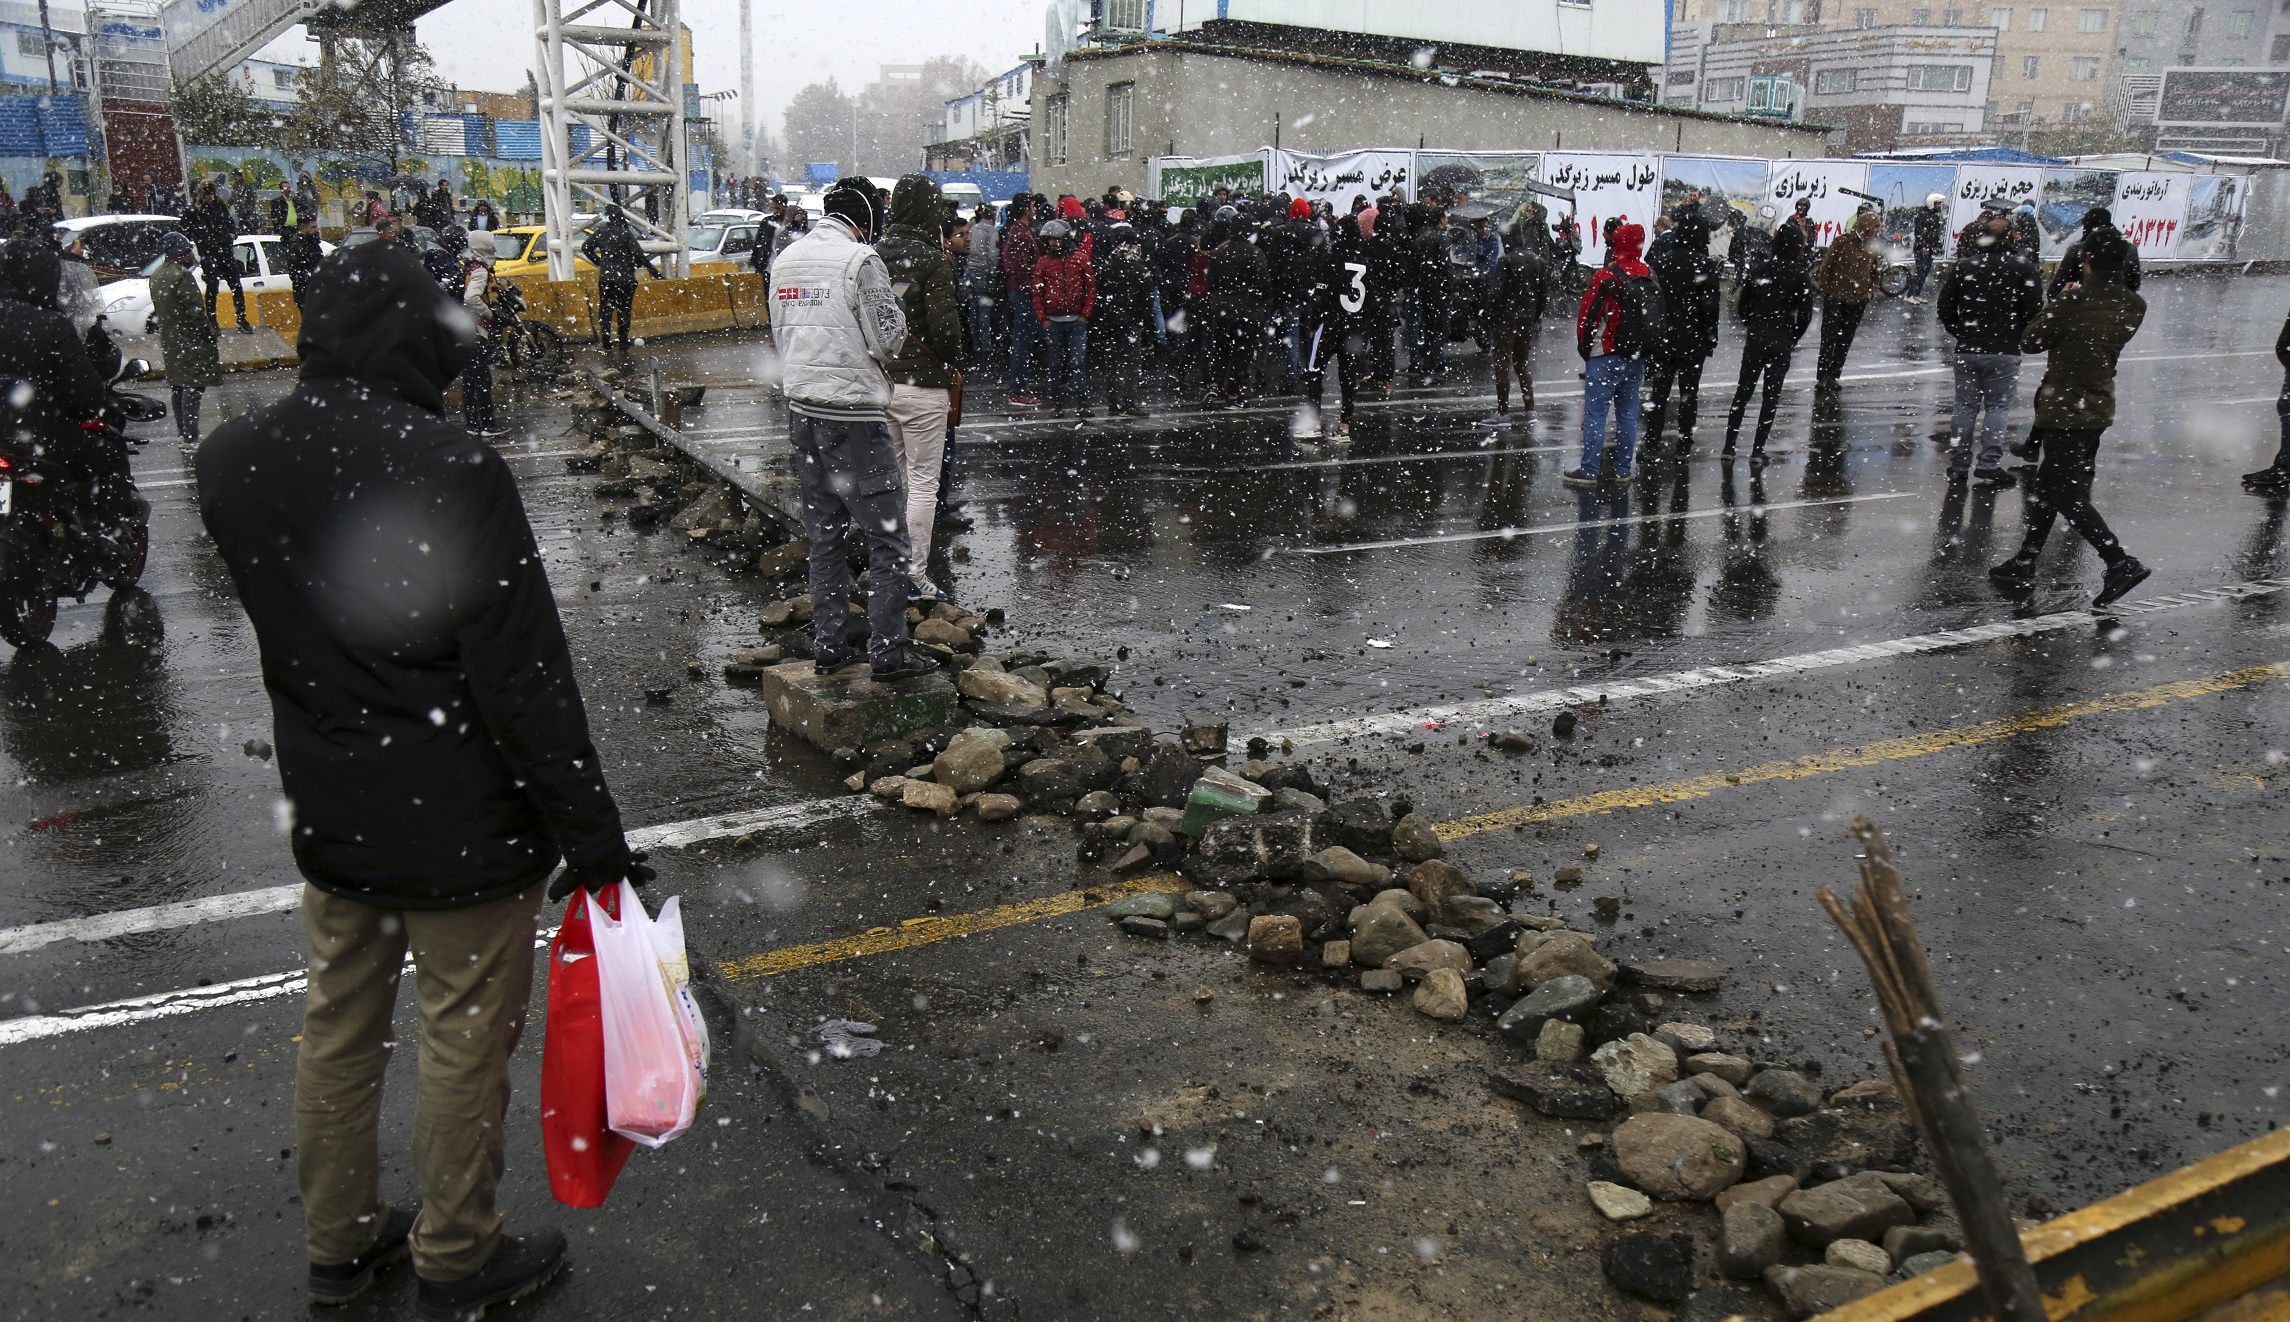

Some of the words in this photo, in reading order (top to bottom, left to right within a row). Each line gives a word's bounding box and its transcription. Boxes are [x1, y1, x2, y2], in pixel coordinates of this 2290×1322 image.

[1279, 160, 1328, 192] زیرگذر
[1329, 170, 1364, 192] مسیر
[1370, 162, 1407, 192] عرض
[1549, 162, 1589, 192] زیرگذر
[1591, 172, 1621, 192] مسیر
[1626, 164, 1655, 192] طول
[2009, 180, 2035, 200] حجم
[1340, 262, 1367, 313] 3
